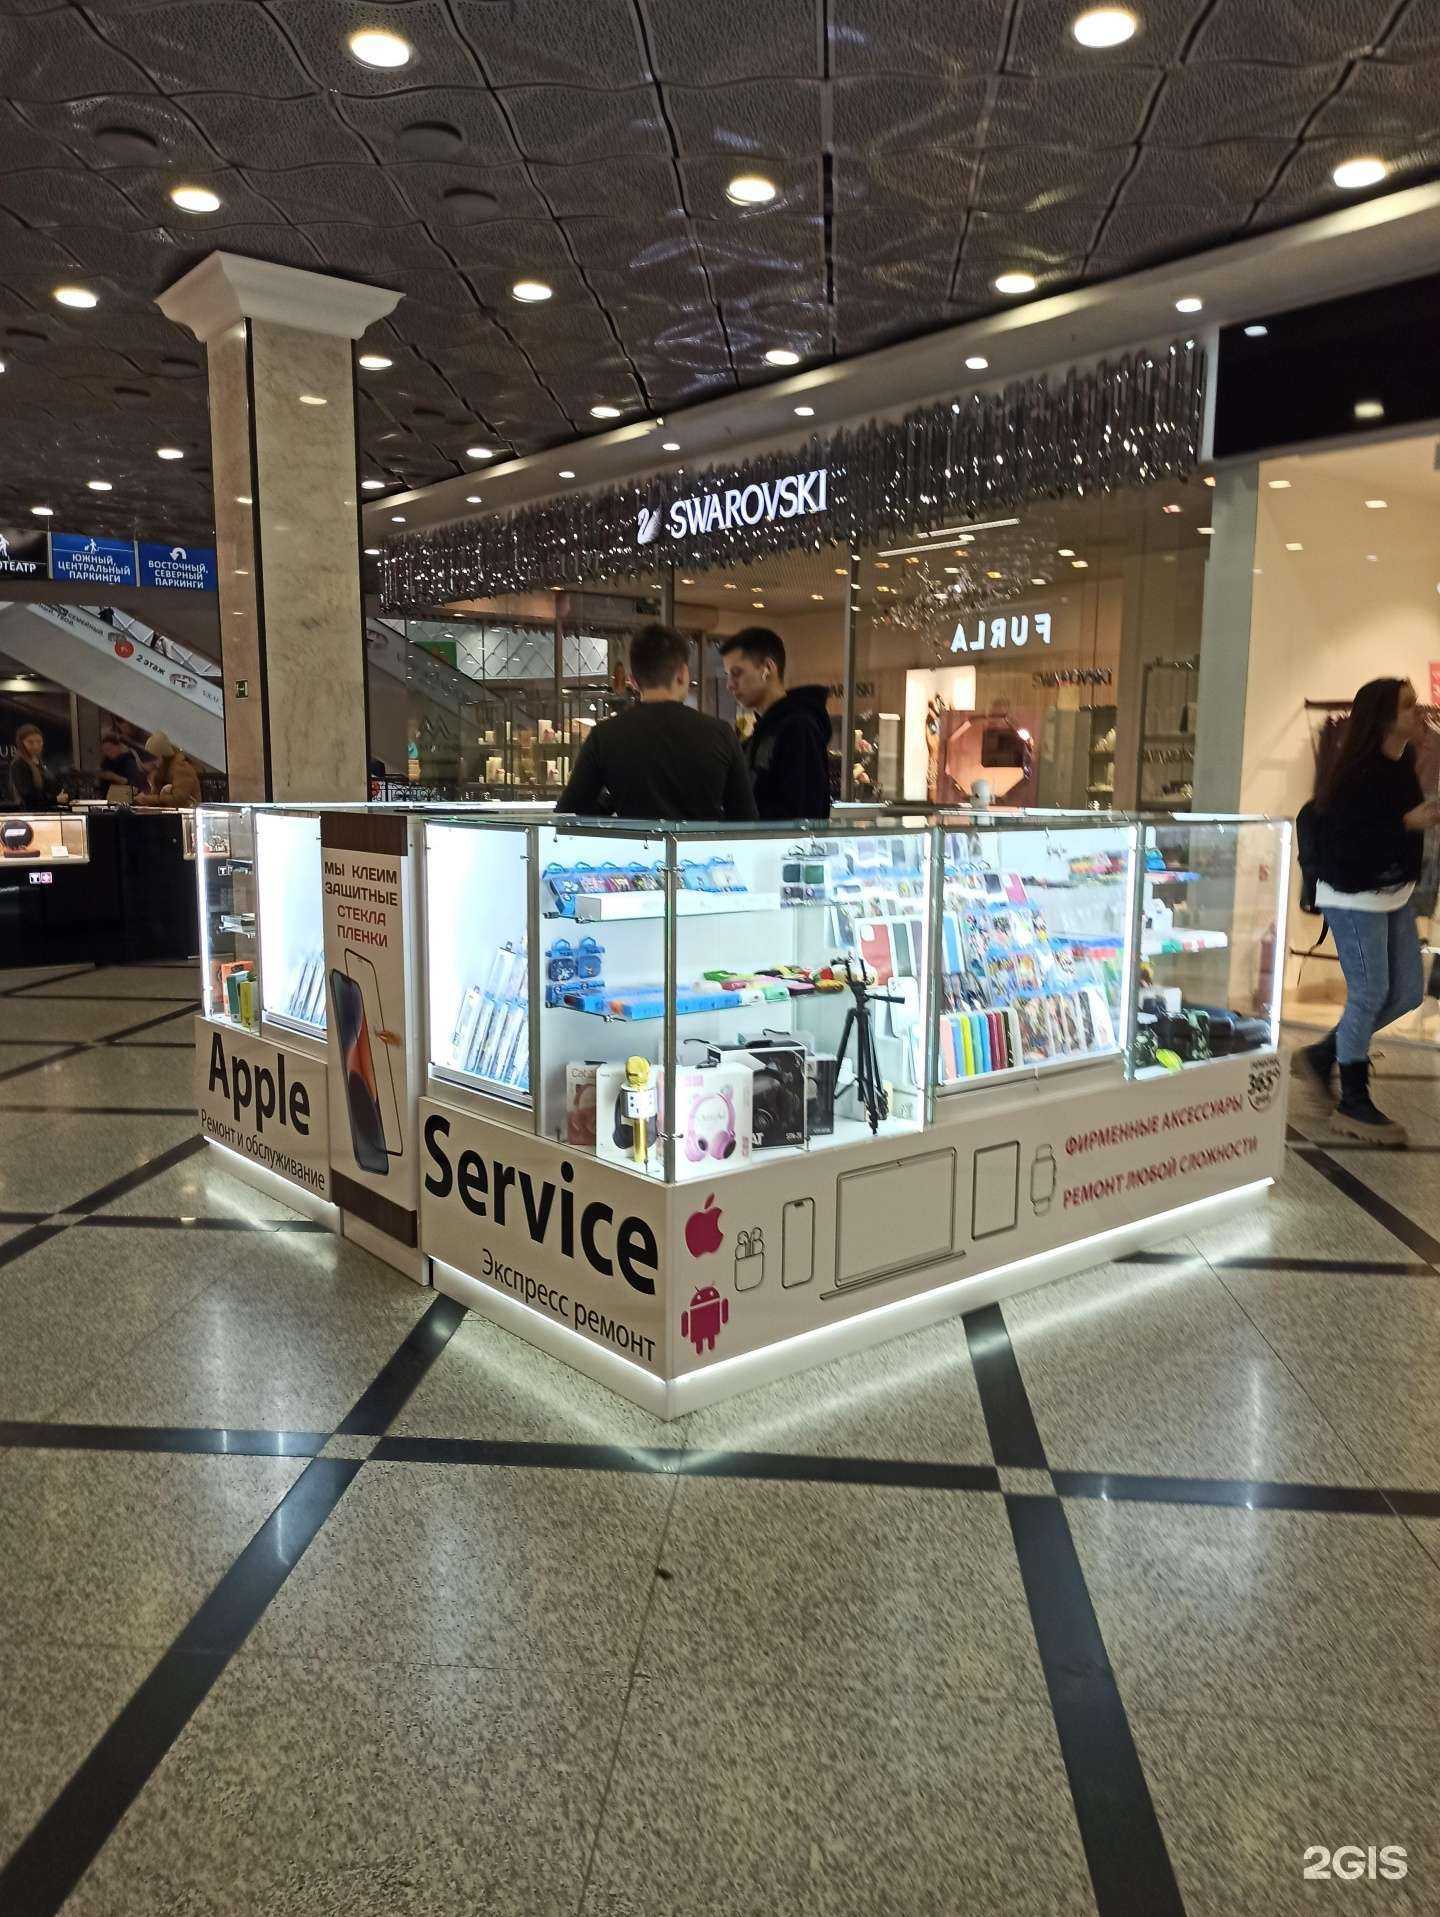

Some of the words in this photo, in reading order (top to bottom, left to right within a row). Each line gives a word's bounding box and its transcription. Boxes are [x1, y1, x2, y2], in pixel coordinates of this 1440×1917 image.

[670, 469, 827, 539] SWAROVSKI
[0, 560, 37, 573] ТЕАТР
[58, 560, 131, 576] ЦЕНТРАЛЬНЫЙ
[72, 553, 116, 567] ЮЖНЫЙ,
[69, 570, 121, 584] ПАРКИНГИ
[154, 569, 204, 581] СЕВЕРНЫЙ
[155, 577, 204, 589] ПАРКИНГИ
[136, 654, 143, 663] 2
[143, 660, 166, 676] этаж
[324, 861, 345, 877] МЫ
[352, 864, 397, 884] КЛЕИМ
[325, 881, 398, 906] ЗАЩИТНЫЕ
[337, 904, 386, 927] СТЕКЛА
[337, 924, 388, 948] ПЛЕНКИ
[208, 1032, 311, 1136] Apple
[1064, 1116, 1160, 1157] ФИРМЕННЫЕ
[1162, 1095, 1243, 1131] АКСЕССУАРЫ
[201, 1108, 236, 1143] Ремонт
[237, 1132, 244, 1147] и
[245, 1133, 326, 1191] обслуживание
[1063, 1175, 1124, 1210] РЕМОНТ
[1126, 1156, 1178, 1191] ЛЮБОЙ
[1179, 1135, 1259, 1174] СЛОЖНОСТИ
[424, 1114, 659, 1295] Service
[482, 1248, 569, 1318] Экспресс
[574, 1300, 656, 1362] ремонт
